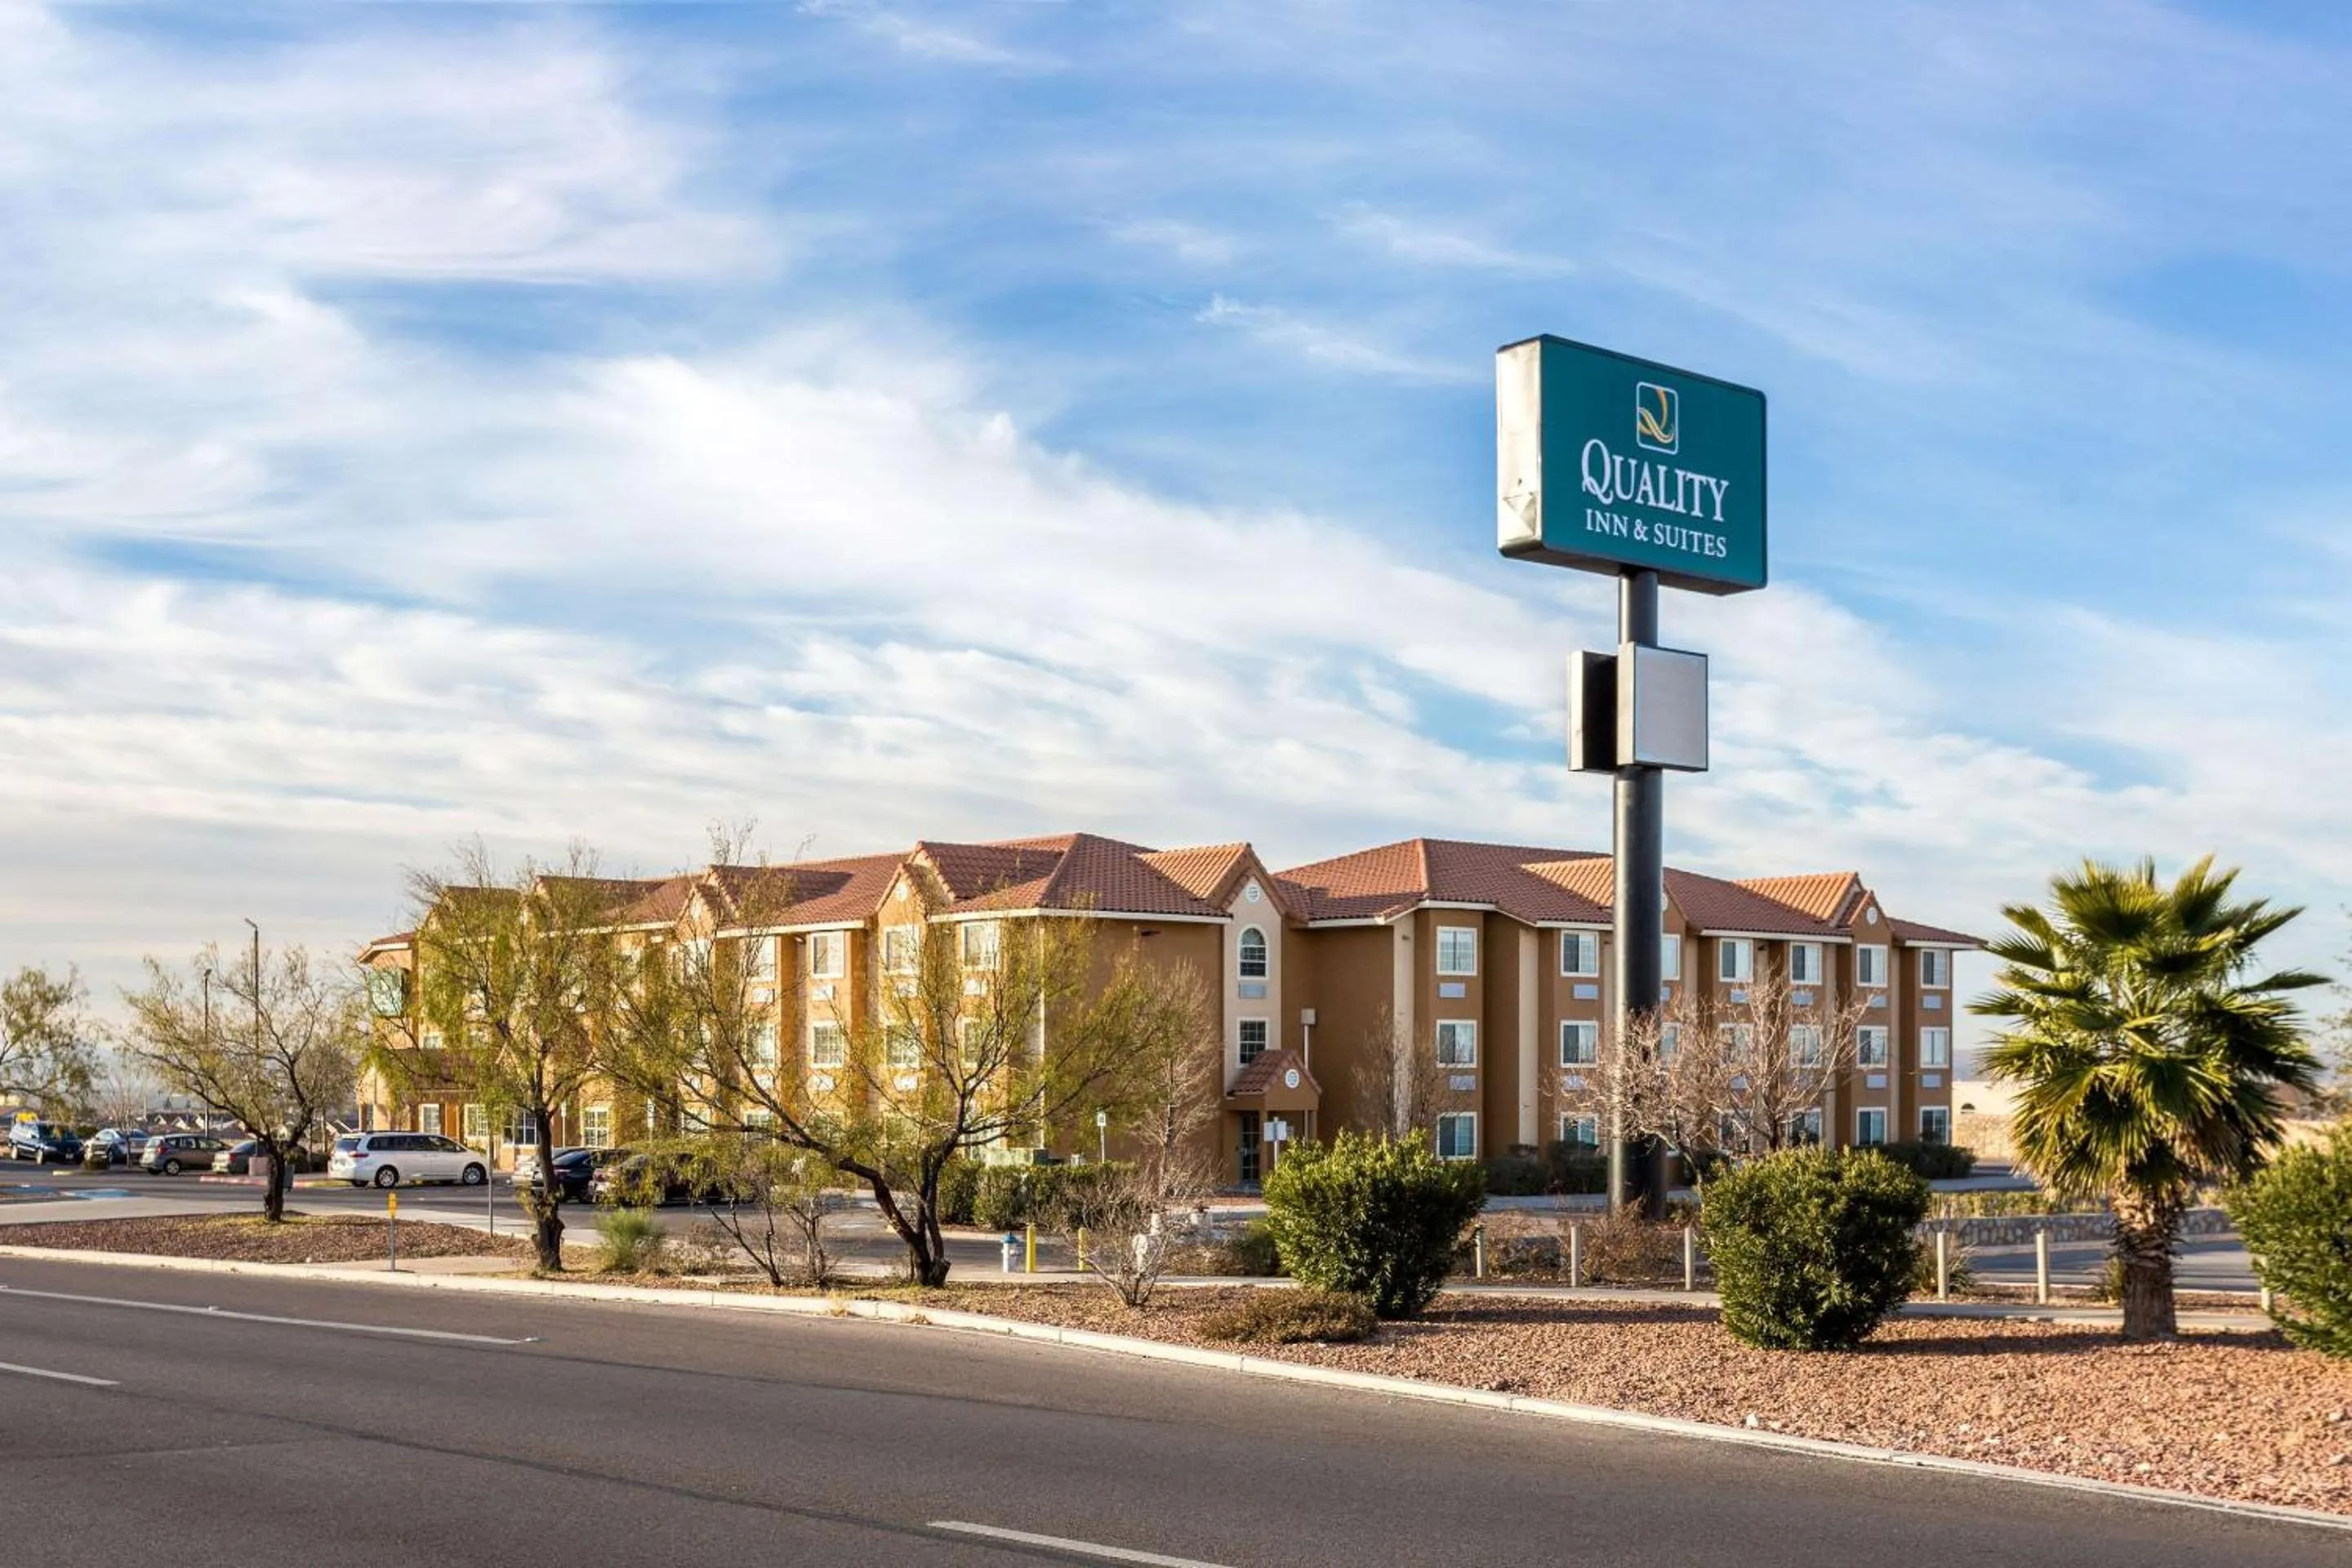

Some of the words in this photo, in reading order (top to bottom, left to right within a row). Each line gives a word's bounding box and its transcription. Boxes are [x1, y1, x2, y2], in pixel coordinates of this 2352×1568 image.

[1581, 439, 1729, 523] QUALITY
[1585, 508, 1629, 538] INN
[1633, 519, 1650, 541] &
[1654, 522, 1727, 558] SUITES
